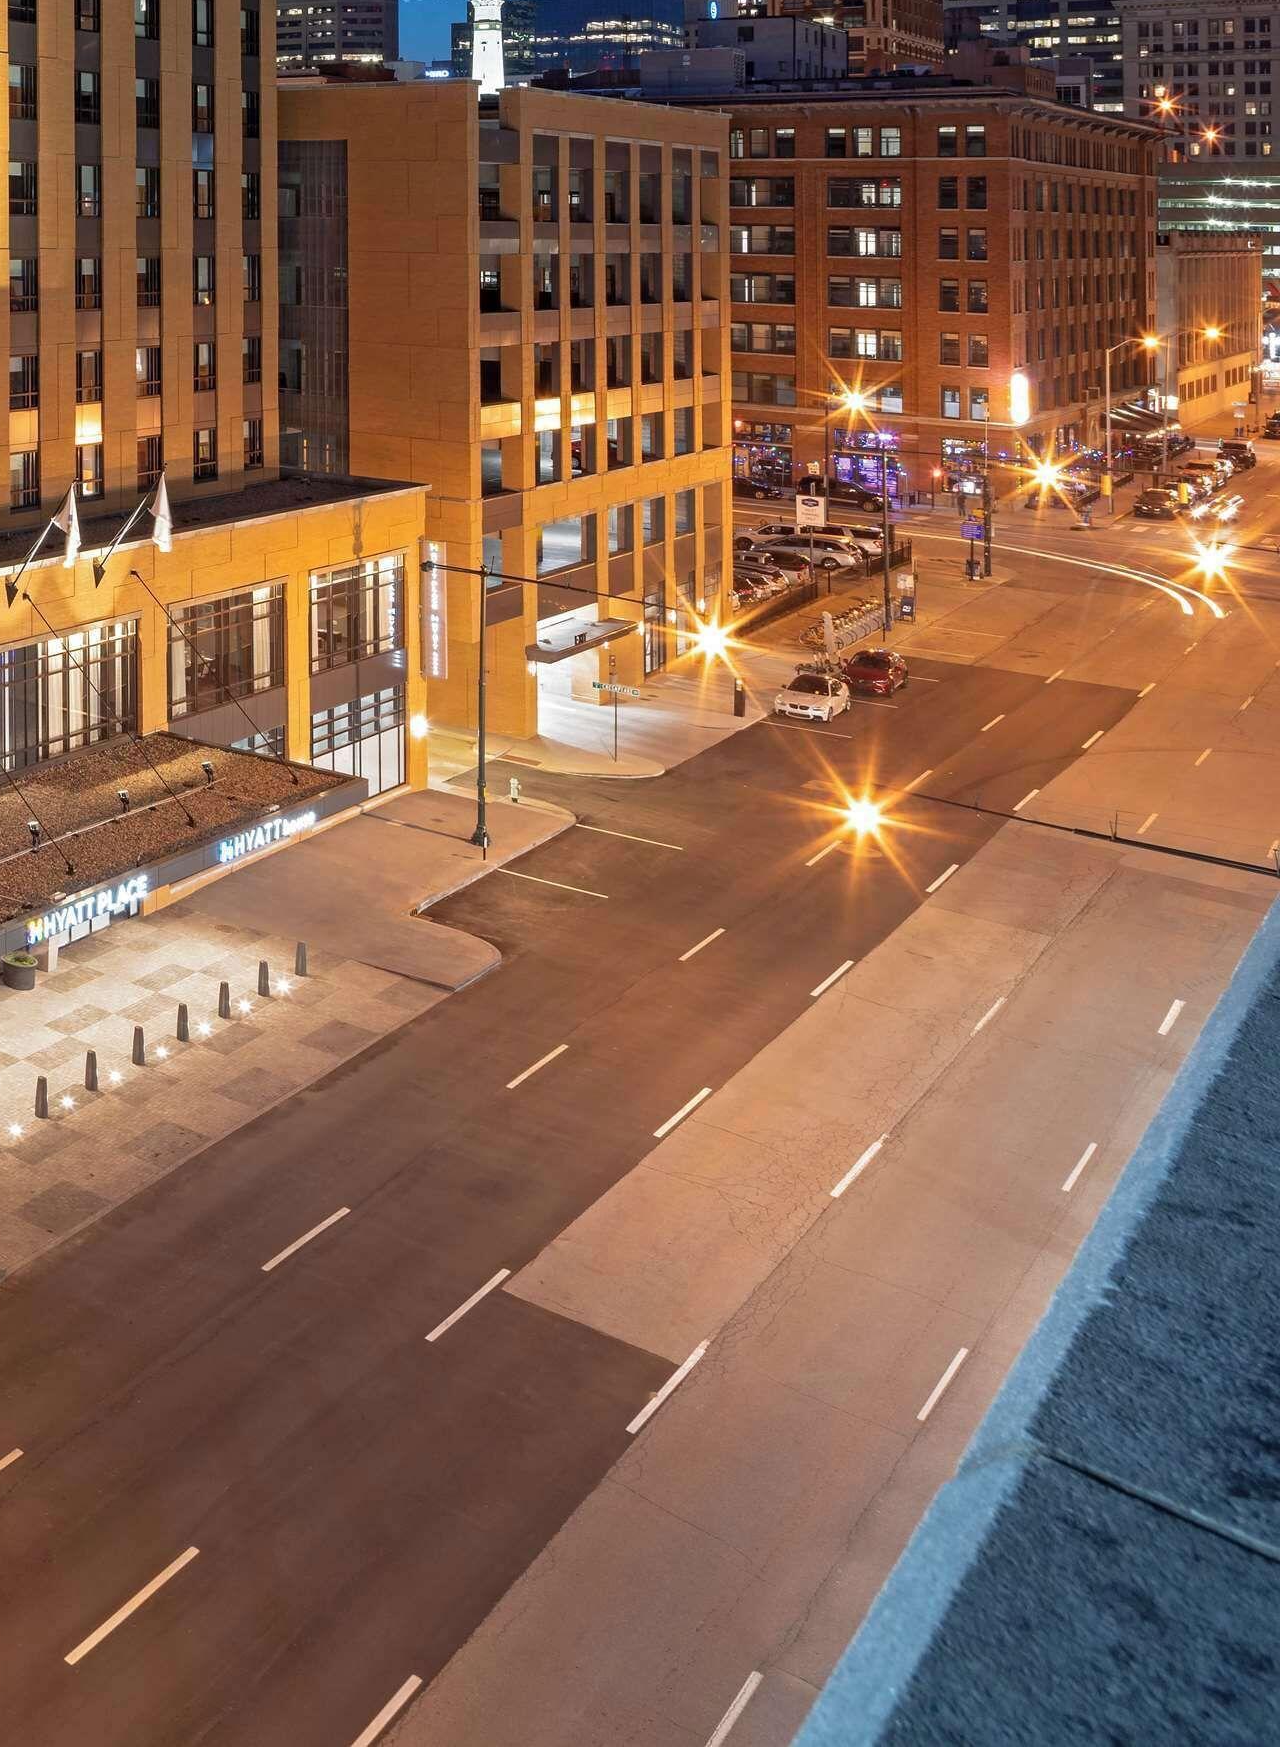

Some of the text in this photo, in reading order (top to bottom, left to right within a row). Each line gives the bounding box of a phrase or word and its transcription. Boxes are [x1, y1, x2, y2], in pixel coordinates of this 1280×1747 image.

[236, 819, 283, 855] HYATT
[43, 896, 95, 939] HYATT
[96, 875, 148, 915] PLACE
